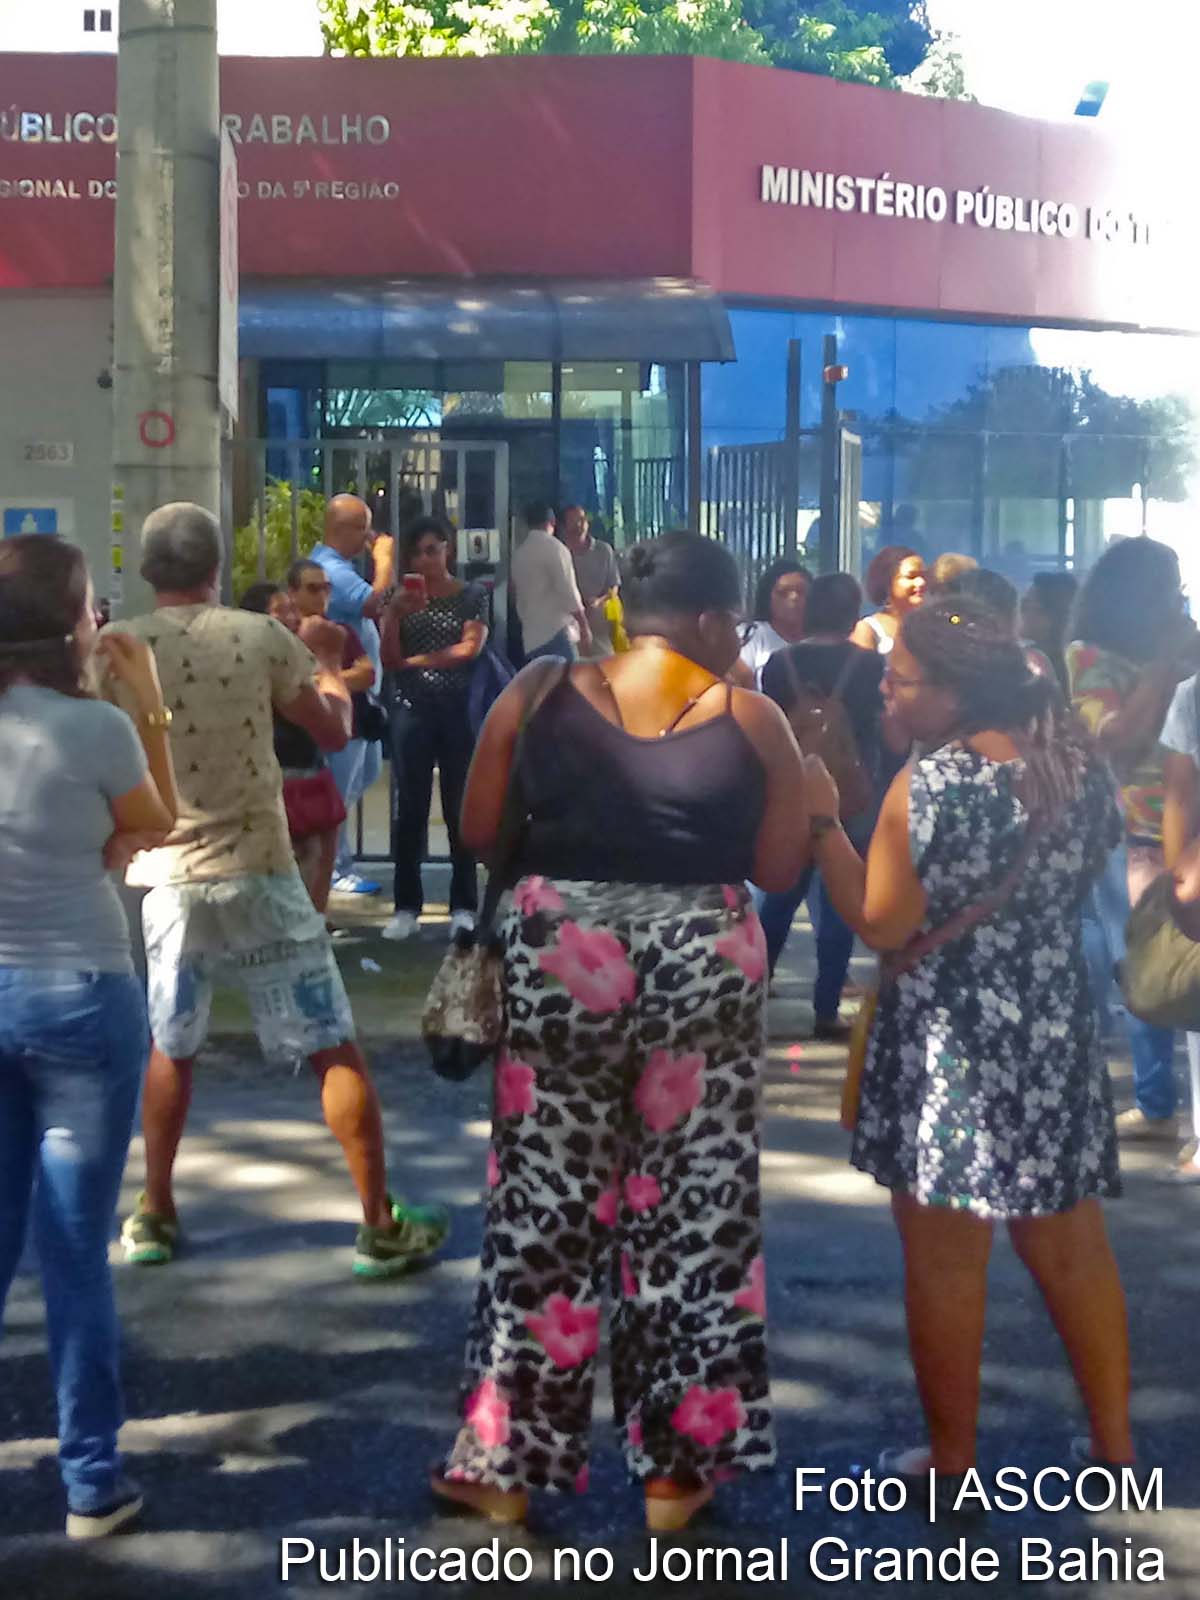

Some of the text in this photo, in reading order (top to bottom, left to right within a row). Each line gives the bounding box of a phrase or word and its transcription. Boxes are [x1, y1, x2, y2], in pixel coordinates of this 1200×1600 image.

[222, 114, 390, 145] RABALHO
[257, 181, 287, 199] DA
[760, 162, 947, 223] MINISTÉRIO
[955, 185, 1079, 239] PÚBLICO
[24, 443, 70, 461] 2563
